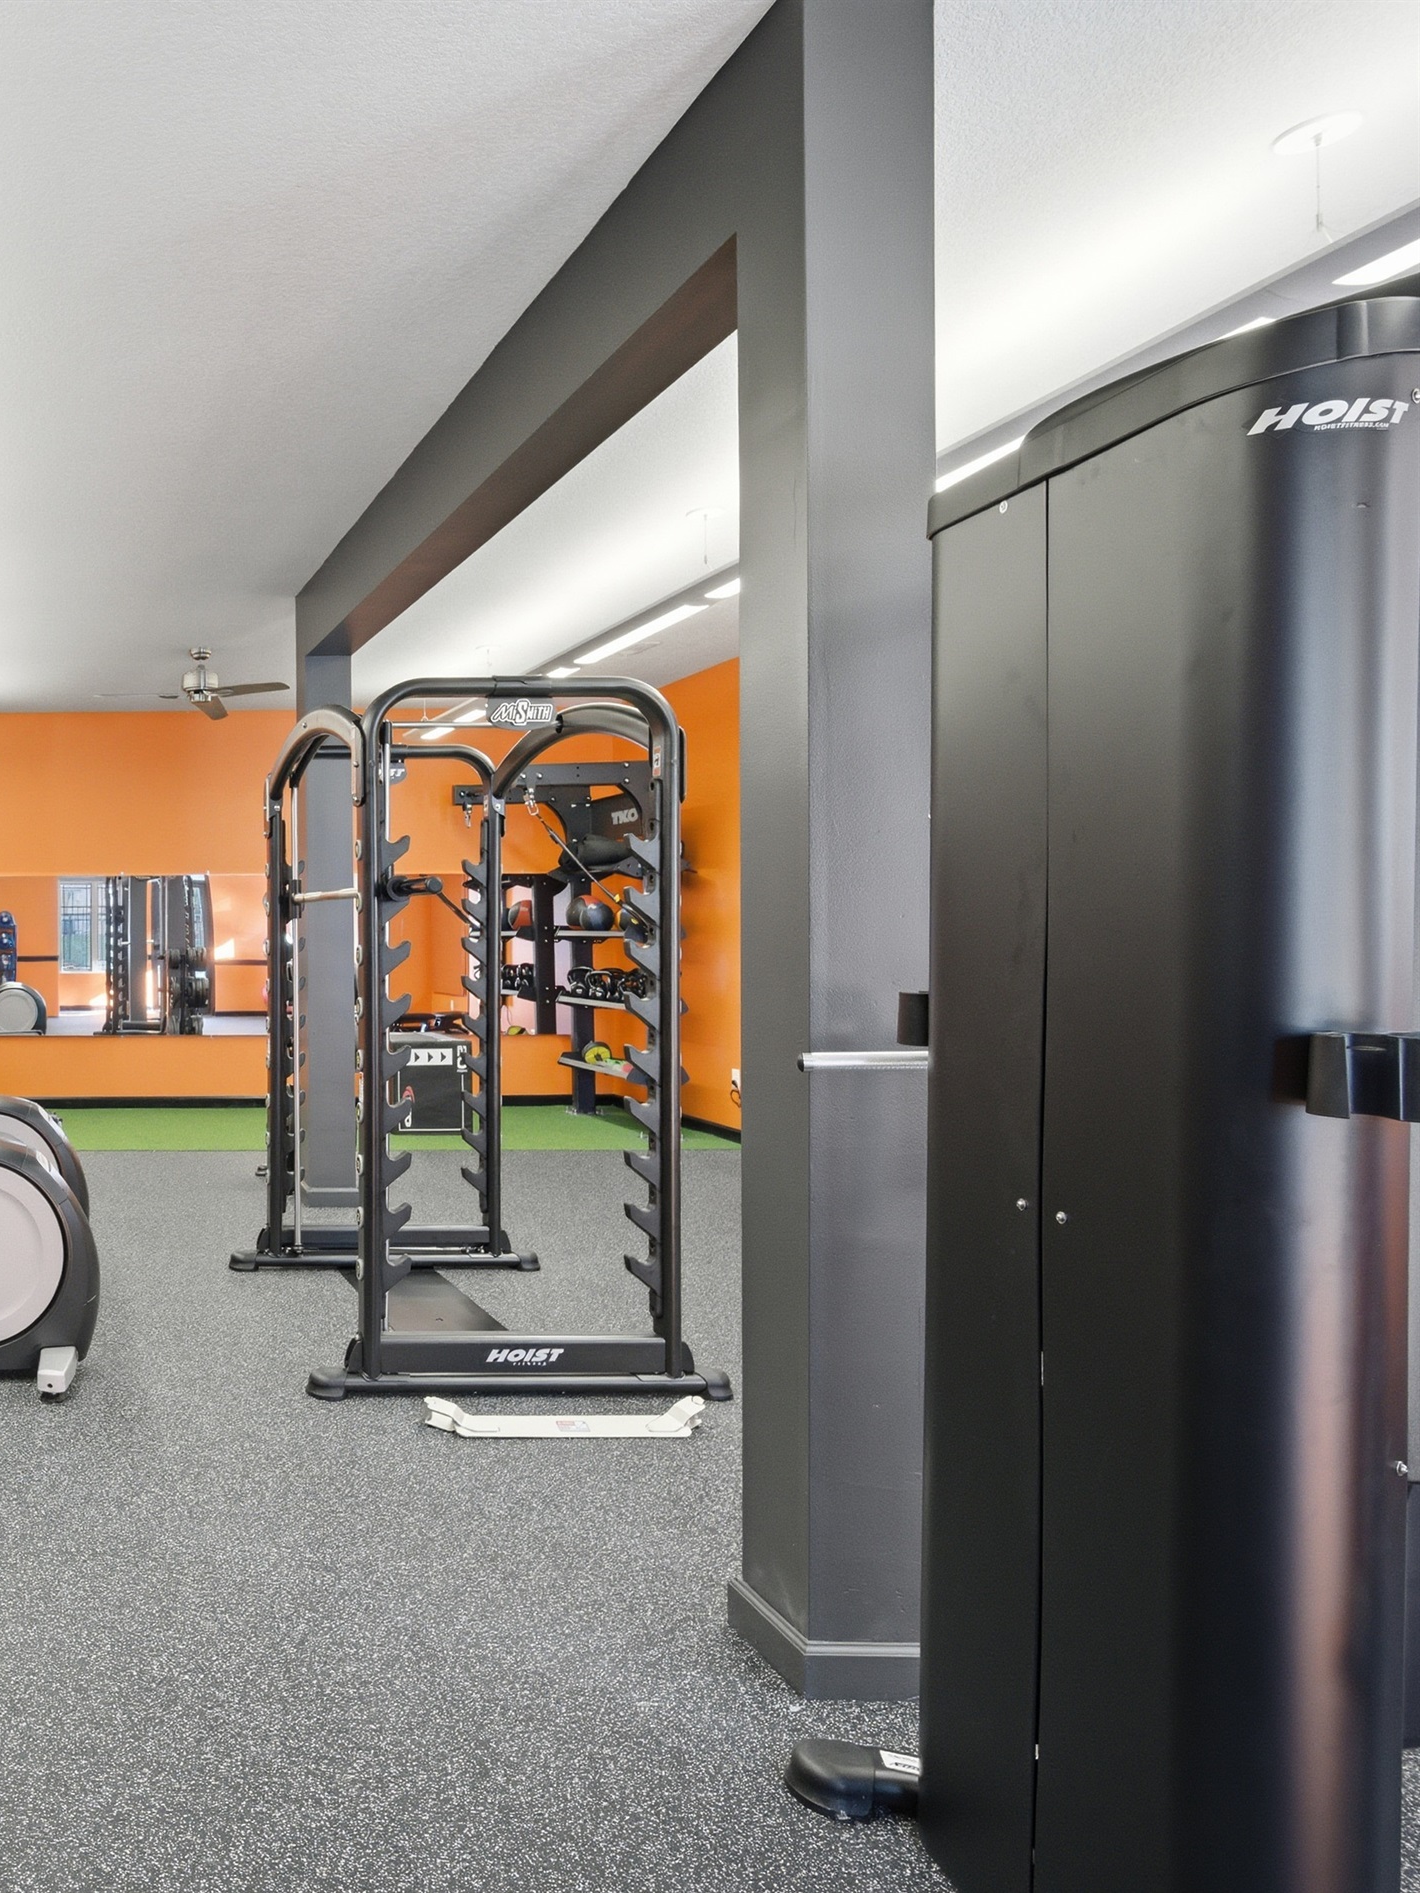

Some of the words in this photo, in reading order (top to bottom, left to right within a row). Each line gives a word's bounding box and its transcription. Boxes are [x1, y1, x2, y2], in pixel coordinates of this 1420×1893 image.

[1246, 397, 1409, 436] HOIST
[611, 807, 639, 825] TKO
[486, 1348, 564, 1362] HOIST
